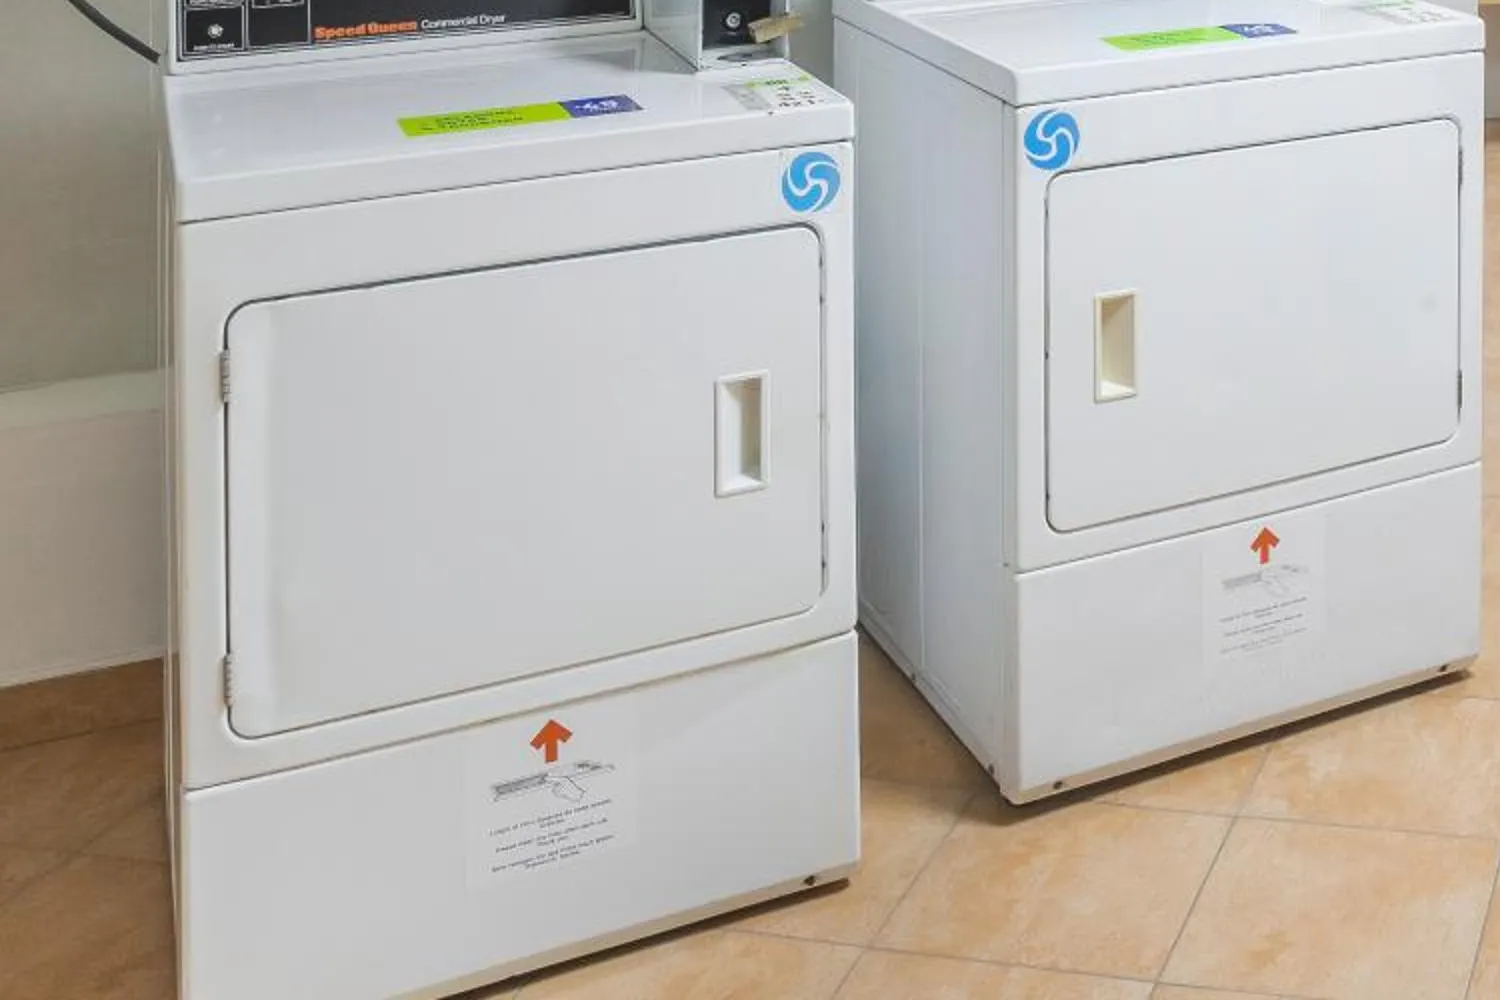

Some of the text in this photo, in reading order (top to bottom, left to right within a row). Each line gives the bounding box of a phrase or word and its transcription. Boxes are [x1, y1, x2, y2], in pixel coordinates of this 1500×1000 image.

[313, 12, 506, 40] Speed Queen Commercial Dryer
